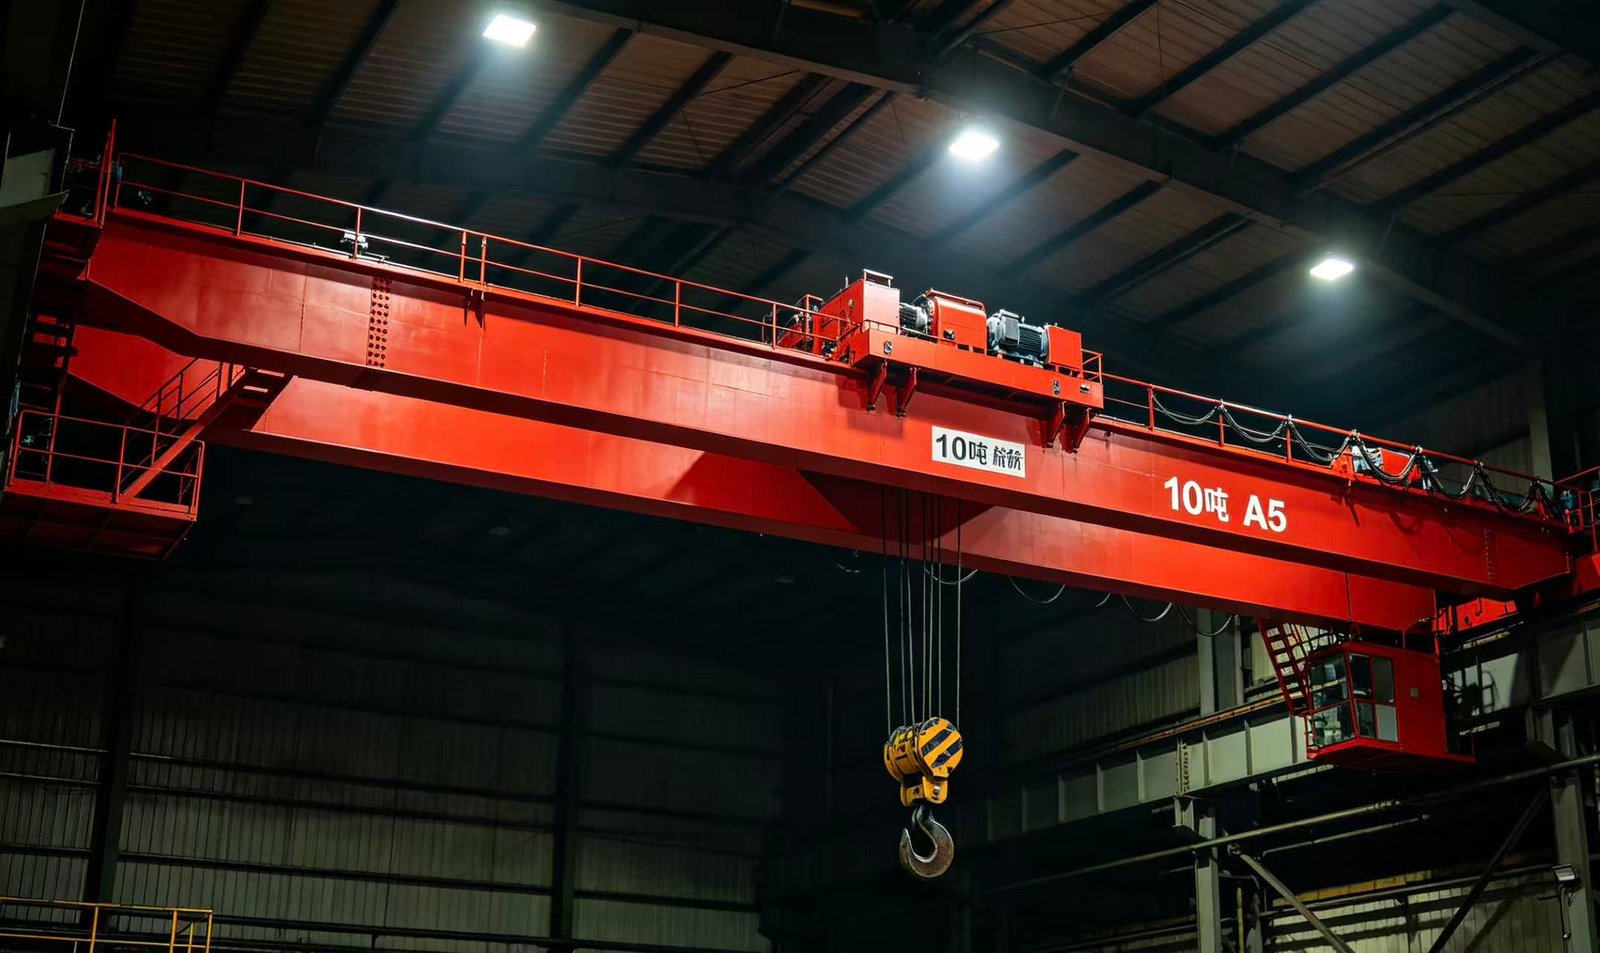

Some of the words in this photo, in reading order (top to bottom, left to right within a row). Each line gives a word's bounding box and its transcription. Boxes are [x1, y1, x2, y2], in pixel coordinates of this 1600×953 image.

[936, 433, 988, 466] 10吨
[1164, 476, 1230, 523] 10吨
[1242, 494, 1287, 533] A5
